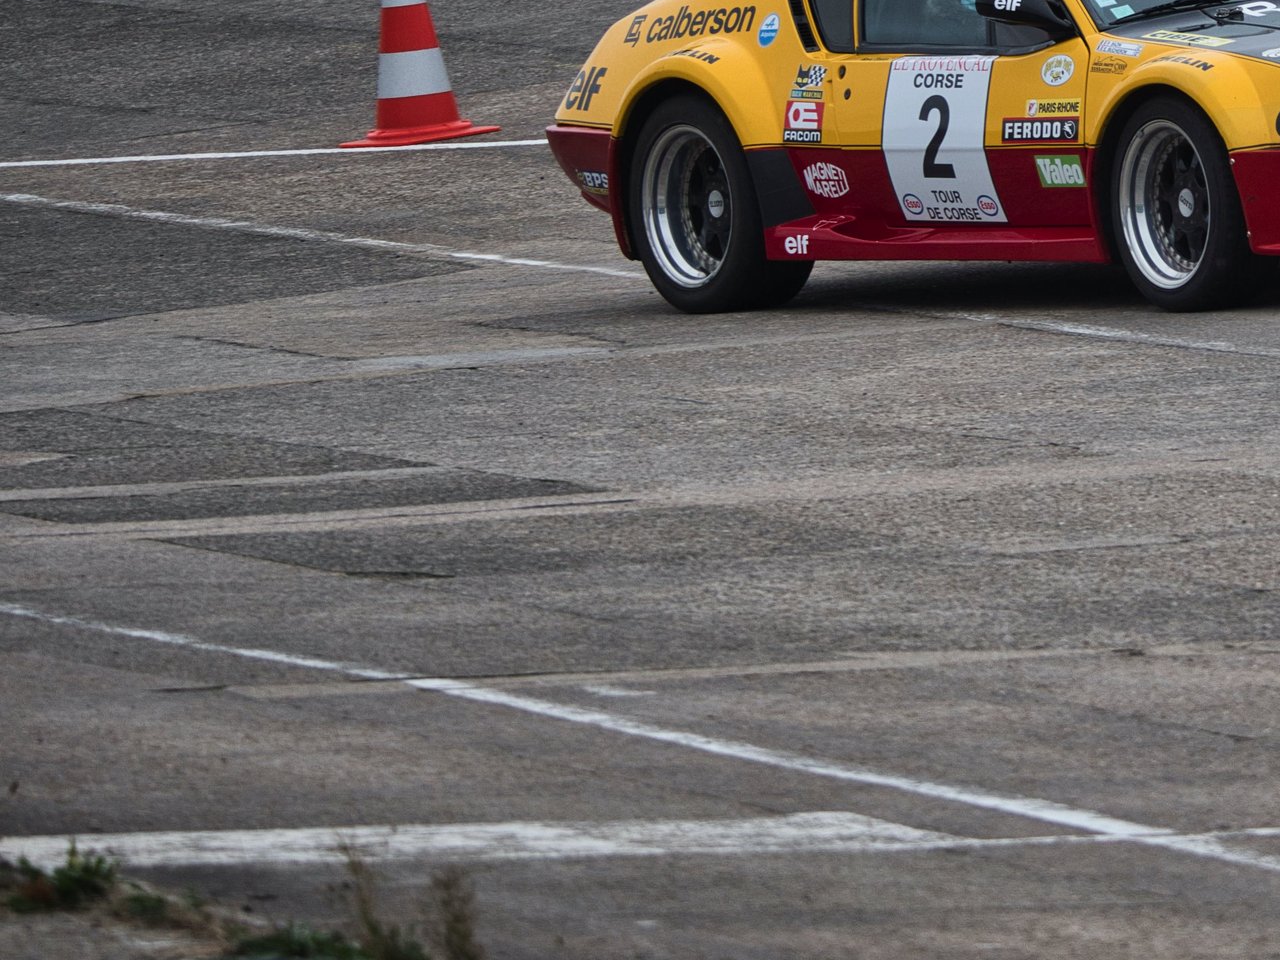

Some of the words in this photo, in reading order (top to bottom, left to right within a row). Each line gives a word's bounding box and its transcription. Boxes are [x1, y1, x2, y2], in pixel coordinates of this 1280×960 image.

[646, 5, 756, 43] calberson
[565, 66, 608, 112] elf
[913, 73, 964, 89] CORSE
[783, 130, 822, 142] FACOM
[918, 94, 957, 179] 2
[1004, 121, 1062, 139] FERODO
[1036, 158, 1085, 185] Valeo
[904, 197, 921, 209] Esso
[930, 190, 963, 203] TOUR
[979, 197, 996, 210] Esso
[926, 207, 944, 220] DE
[943, 208, 983, 221] CORSE
[784, 235, 809, 255] elf
